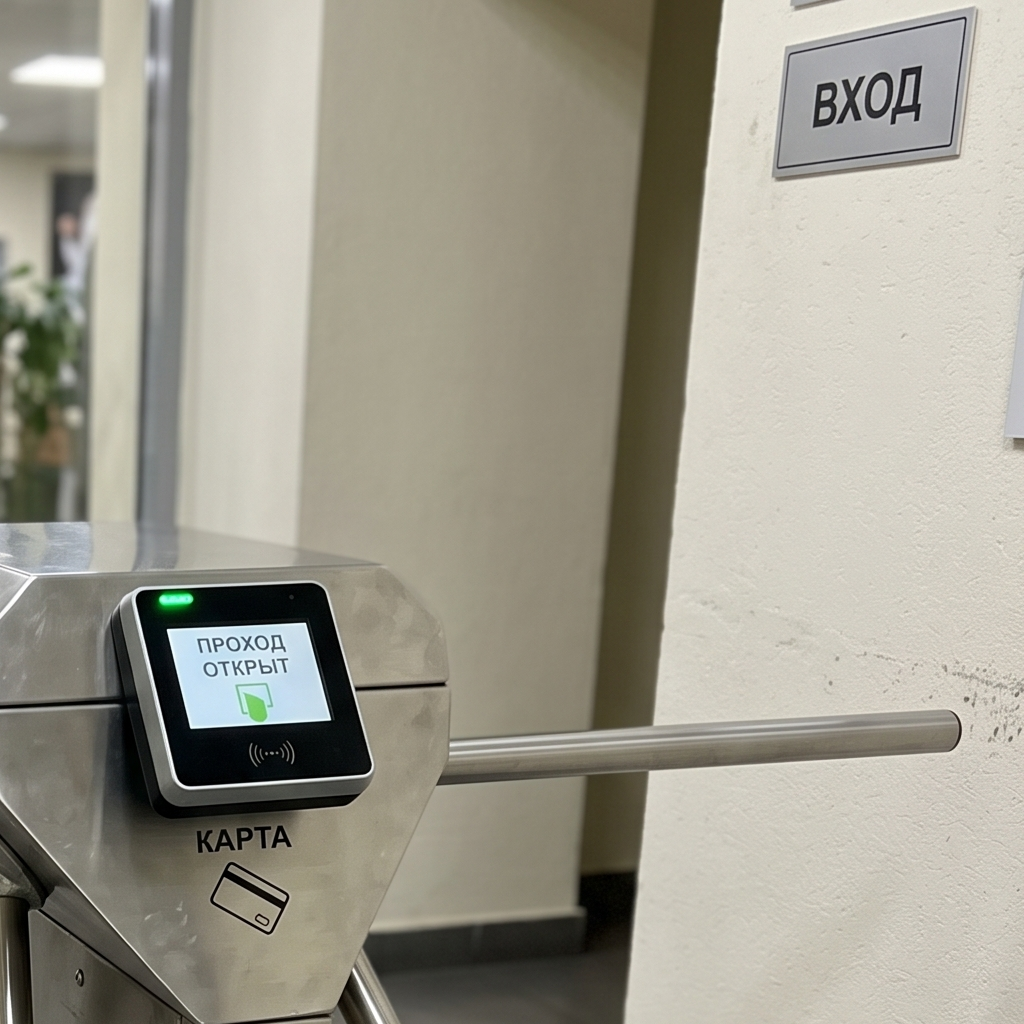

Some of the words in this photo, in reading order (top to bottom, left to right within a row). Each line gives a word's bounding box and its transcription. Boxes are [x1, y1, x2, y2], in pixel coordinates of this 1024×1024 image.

[812, 65, 923, 128] ВХОД
[196, 634, 287, 653] ПРОХОД
[202, 657, 289, 678] ОТКРЫТ
[196, 825, 292, 853] КАРТА
